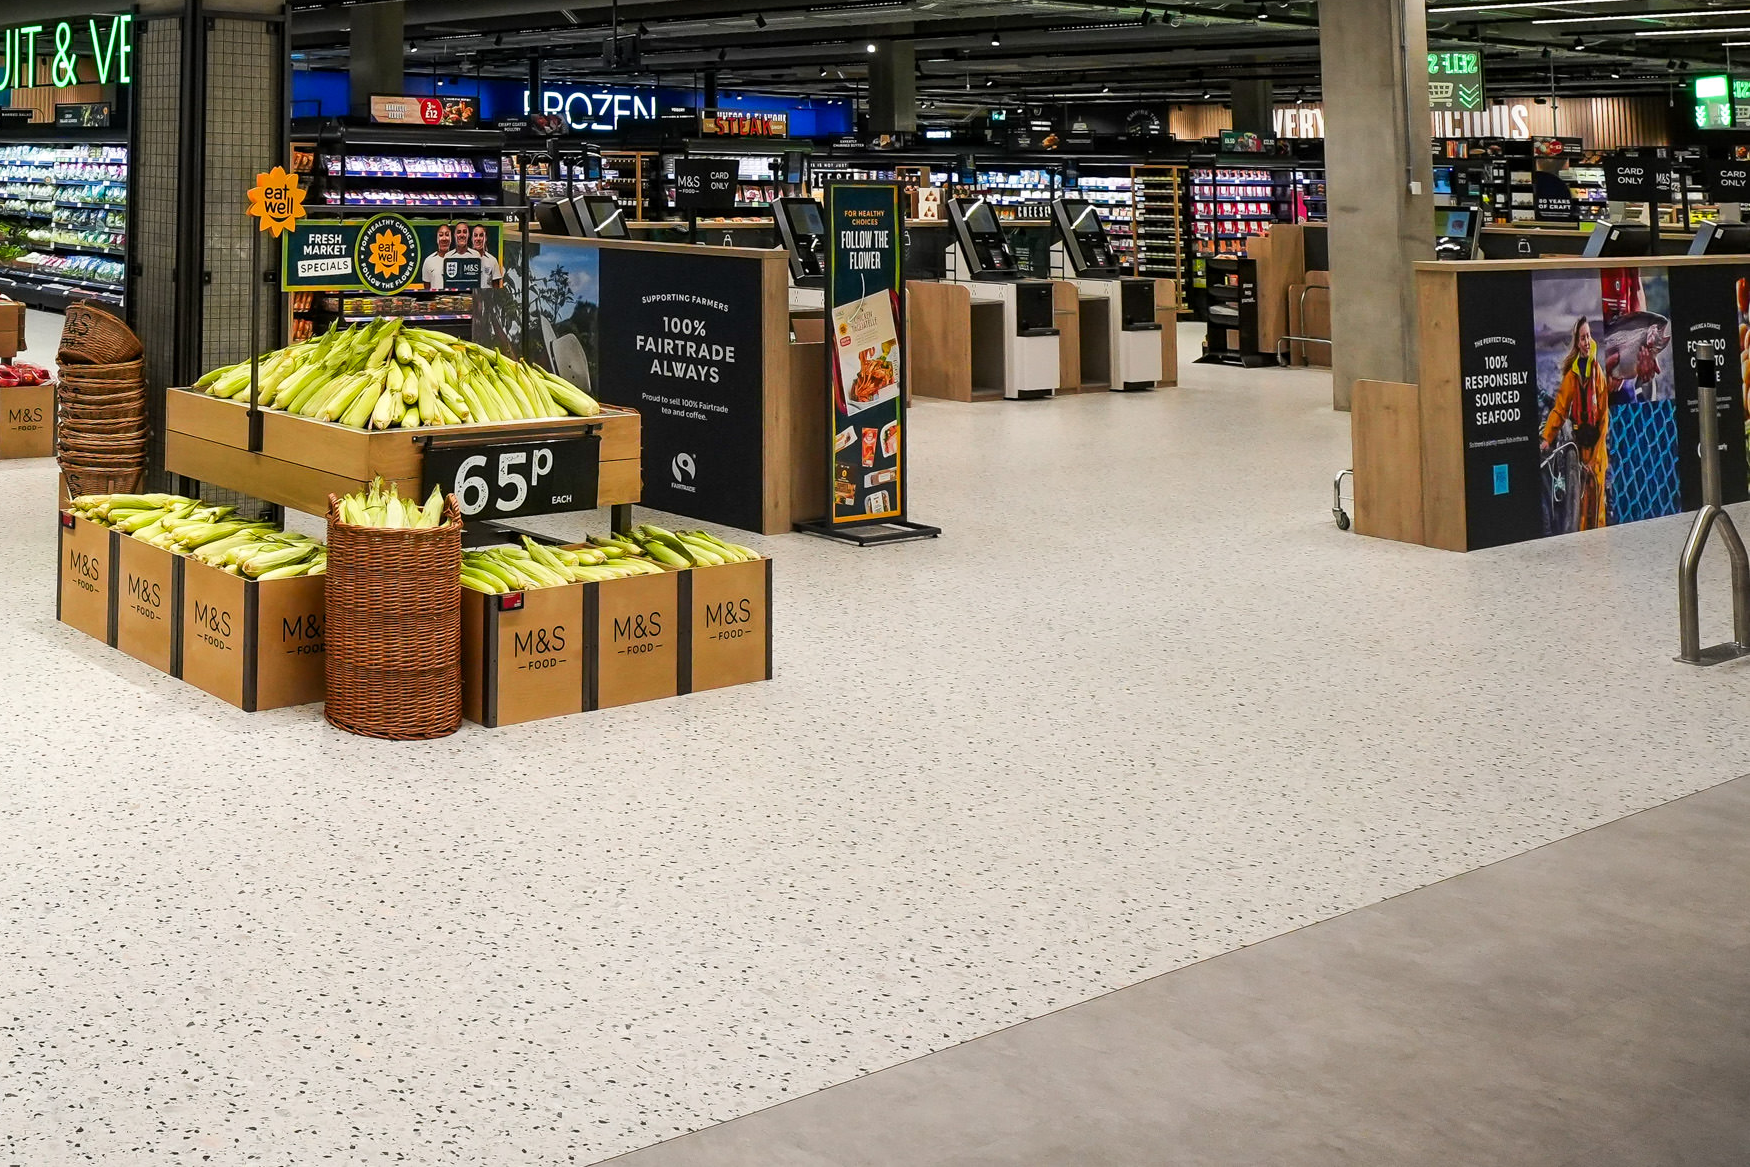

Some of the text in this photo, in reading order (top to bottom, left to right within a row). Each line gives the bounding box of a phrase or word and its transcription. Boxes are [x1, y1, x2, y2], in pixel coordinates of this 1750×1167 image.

[52, 22, 77, 88] &
[89, 15, 132, 84] VE
[425, 110, 438, 118] £12
[715, 117, 773, 136] STEAK
[710, 171, 729, 179] CARD
[1617, 167, 1644, 175] CARD
[1720, 170, 1747, 178] CARD
[677, 175, 700, 188] M&S
[710, 181, 729, 190] ONLY
[1617, 177, 1644, 185] ONLY
[1720, 179, 1747, 187] ONLY
[264, 184, 290, 200] eat
[264, 197, 293, 214] well
[1017, 205, 1048, 218] CHEESE
[308, 234, 342, 244] FRESH
[360, 219, 415, 251] FOR HEALTHY CHOICES
[841, 230, 889, 249] FOLLOW THE
[303, 245, 347, 255] MARKET
[378, 242, 395, 252] eat
[378, 250, 398, 263] well
[849, 251, 881, 270] FLOWER
[300, 260, 349, 273] SPECIALS
[463, 264, 479, 272] M&S
[360, 261, 415, 289] FOLLOW THE FLOWER
[641, 293, 729, 312] SUPPORTING FARMERS
[663, 316, 706, 337] 100%
[636, 335, 735, 363] FAIRTRADE
[1474, 336, 1516, 348] THE PERFECT CATCH
[1484, 355, 1508, 370] 100%
[650, 359, 720, 384] ALWAYS
[1465, 371, 1528, 390] RESPONSIBLY
[642, 392, 729, 414] Proud to sell 100% Fairtrade
[1475, 390, 1520, 407] SOURCED
[9, 407, 43, 423] M&S
[661, 406, 708, 421] tea and coffee.
[1476, 408, 1521, 426] SEAFOOD
[453, 448, 553, 517] 65p
[671, 482, 696, 493] FAIRTRADE
[551, 494, 572, 504] EACH
[70, 549, 100, 581] M&S
[77, 580, 95, 592] FOOD
[128, 573, 162, 608] M&S
[136, 606, 156, 620] FOOD
[194, 600, 232, 637] M&S
[706, 598, 751, 629] M&S
[282, 613, 326, 643] M&
[613, 611, 662, 642] M&S
[514, 625, 567, 658] M&S
[718, 629, 744, 640] FOOD
[203, 635, 226, 650] FOOD
[627, 642, 654, 654] FOOD
[528, 658, 556, 670] FOOD
